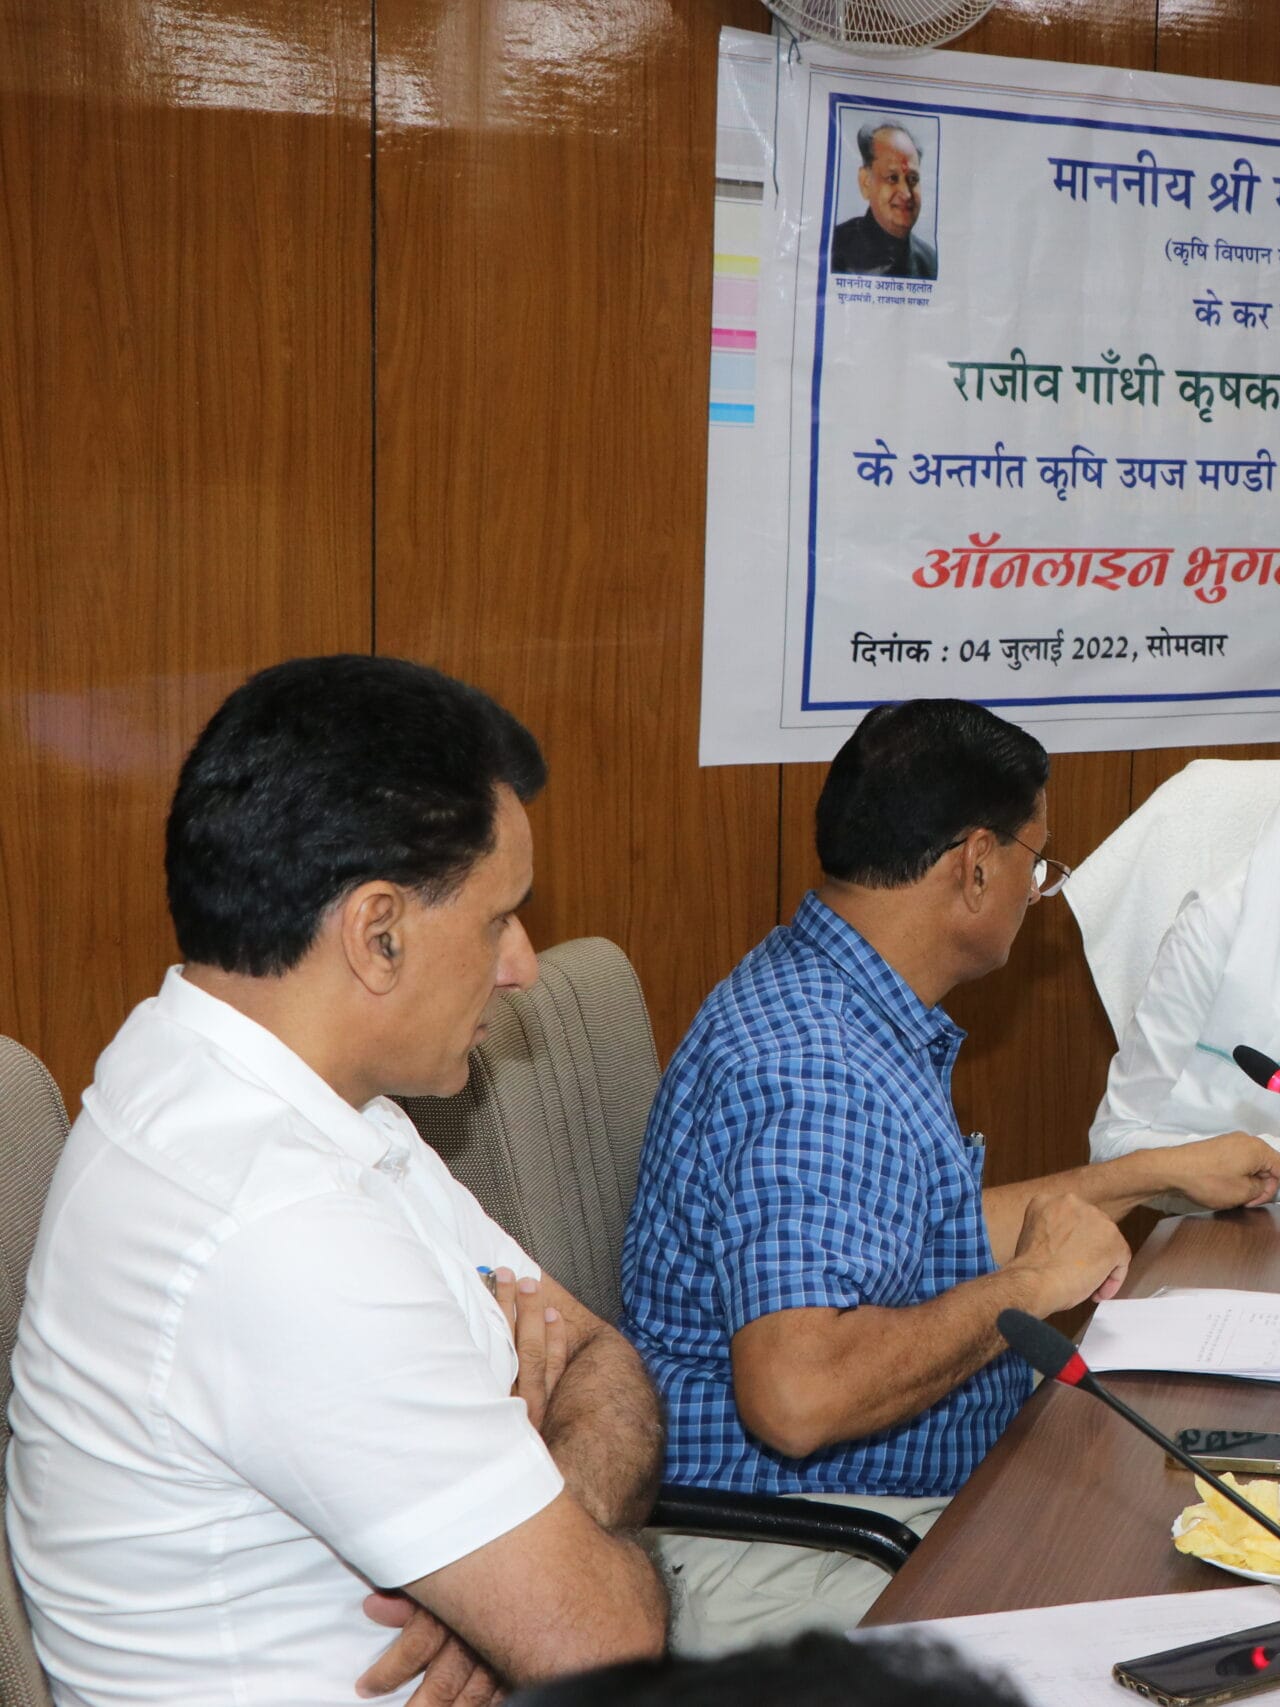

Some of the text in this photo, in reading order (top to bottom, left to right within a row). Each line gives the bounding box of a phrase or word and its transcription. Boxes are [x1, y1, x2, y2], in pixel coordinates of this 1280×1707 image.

[1048, 149, 1196, 209] माननीय
[1208, 158, 1261, 214] श्री
[1165, 236, 1209, 266] (कृषि
[1215, 239, 1272, 264] विपणन
[836, 276, 933, 293] माननीय अशोक गहलोत
[1193, 289, 1223, 326] के
[1230, 301, 1273, 329] कर
[948, 347, 1063, 403] राजीव
[1072, 349, 1165, 406] गाँधी
[853, 439, 897, 487] के
[909, 441, 1028, 488] अन्तर्गत
[1036, 445, 1108, 501] कृषि
[1116, 458, 1188, 490] उपज
[1195, 449, 1277, 492] मण्डी
[912, 532, 1174, 591] ऑनलाइन
[850, 631, 933, 667] दिनांक
[960, 640, 991, 662] 04
[999, 628, 1064, 670] जुलाई
[1072, 636, 1138, 662] 2022,
[1145, 627, 1229, 658] सोमवार
